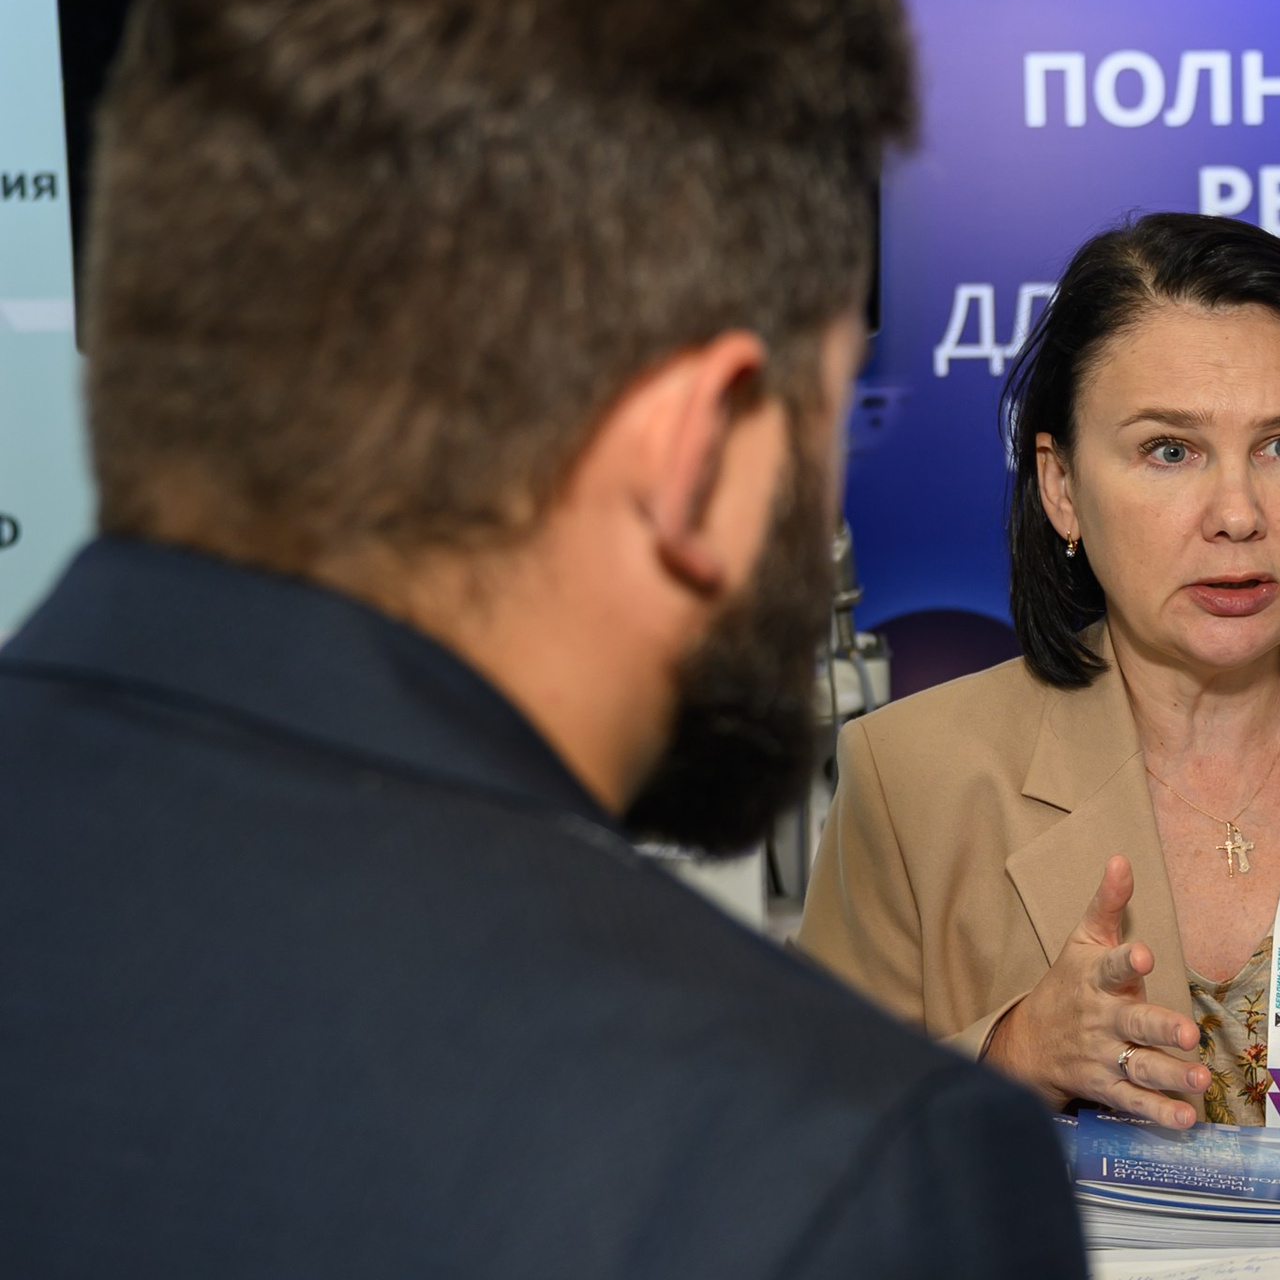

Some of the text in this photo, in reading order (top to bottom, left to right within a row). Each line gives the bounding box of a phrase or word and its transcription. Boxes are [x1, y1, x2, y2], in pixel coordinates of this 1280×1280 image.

[934, 282, 1061, 378] ДЛ
[1096, 1114, 1157, 1124] OLYMP
[1114, 1158, 1219, 1173] ПОРТФОЛИО
[1113, 1168, 1243, 1186] ДЛЯ УРОЛОГИИ
[1131, 1174, 1255, 1192] ГИНЕКОЛОГИИ
